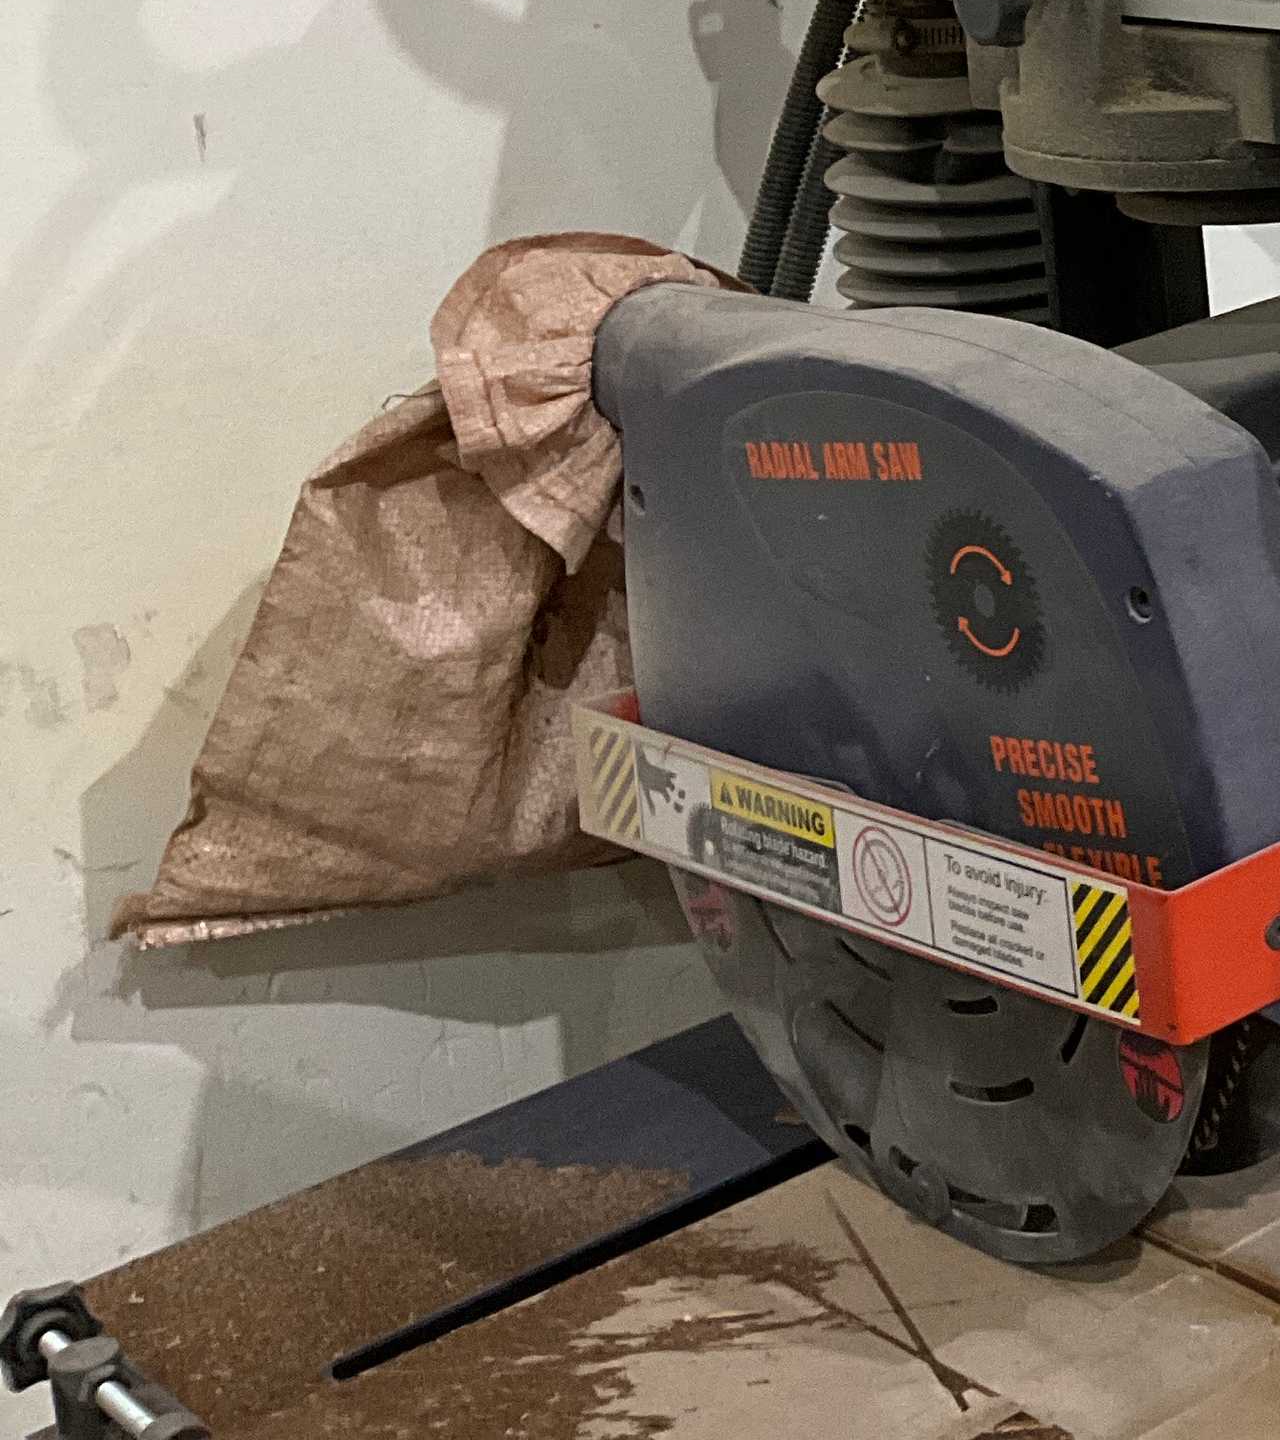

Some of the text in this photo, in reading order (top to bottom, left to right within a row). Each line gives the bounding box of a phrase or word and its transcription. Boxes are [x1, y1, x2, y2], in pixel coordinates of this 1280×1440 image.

[745, 441, 923, 481] RADIAL ARM SAW
[989, 735, 1100, 784] PRECISE
[735, 784, 826, 836] WARNING
[1017, 788, 1128, 839] SMOOTH
[944, 854, 961, 876] To
[964, 864, 1001, 888] avoid
